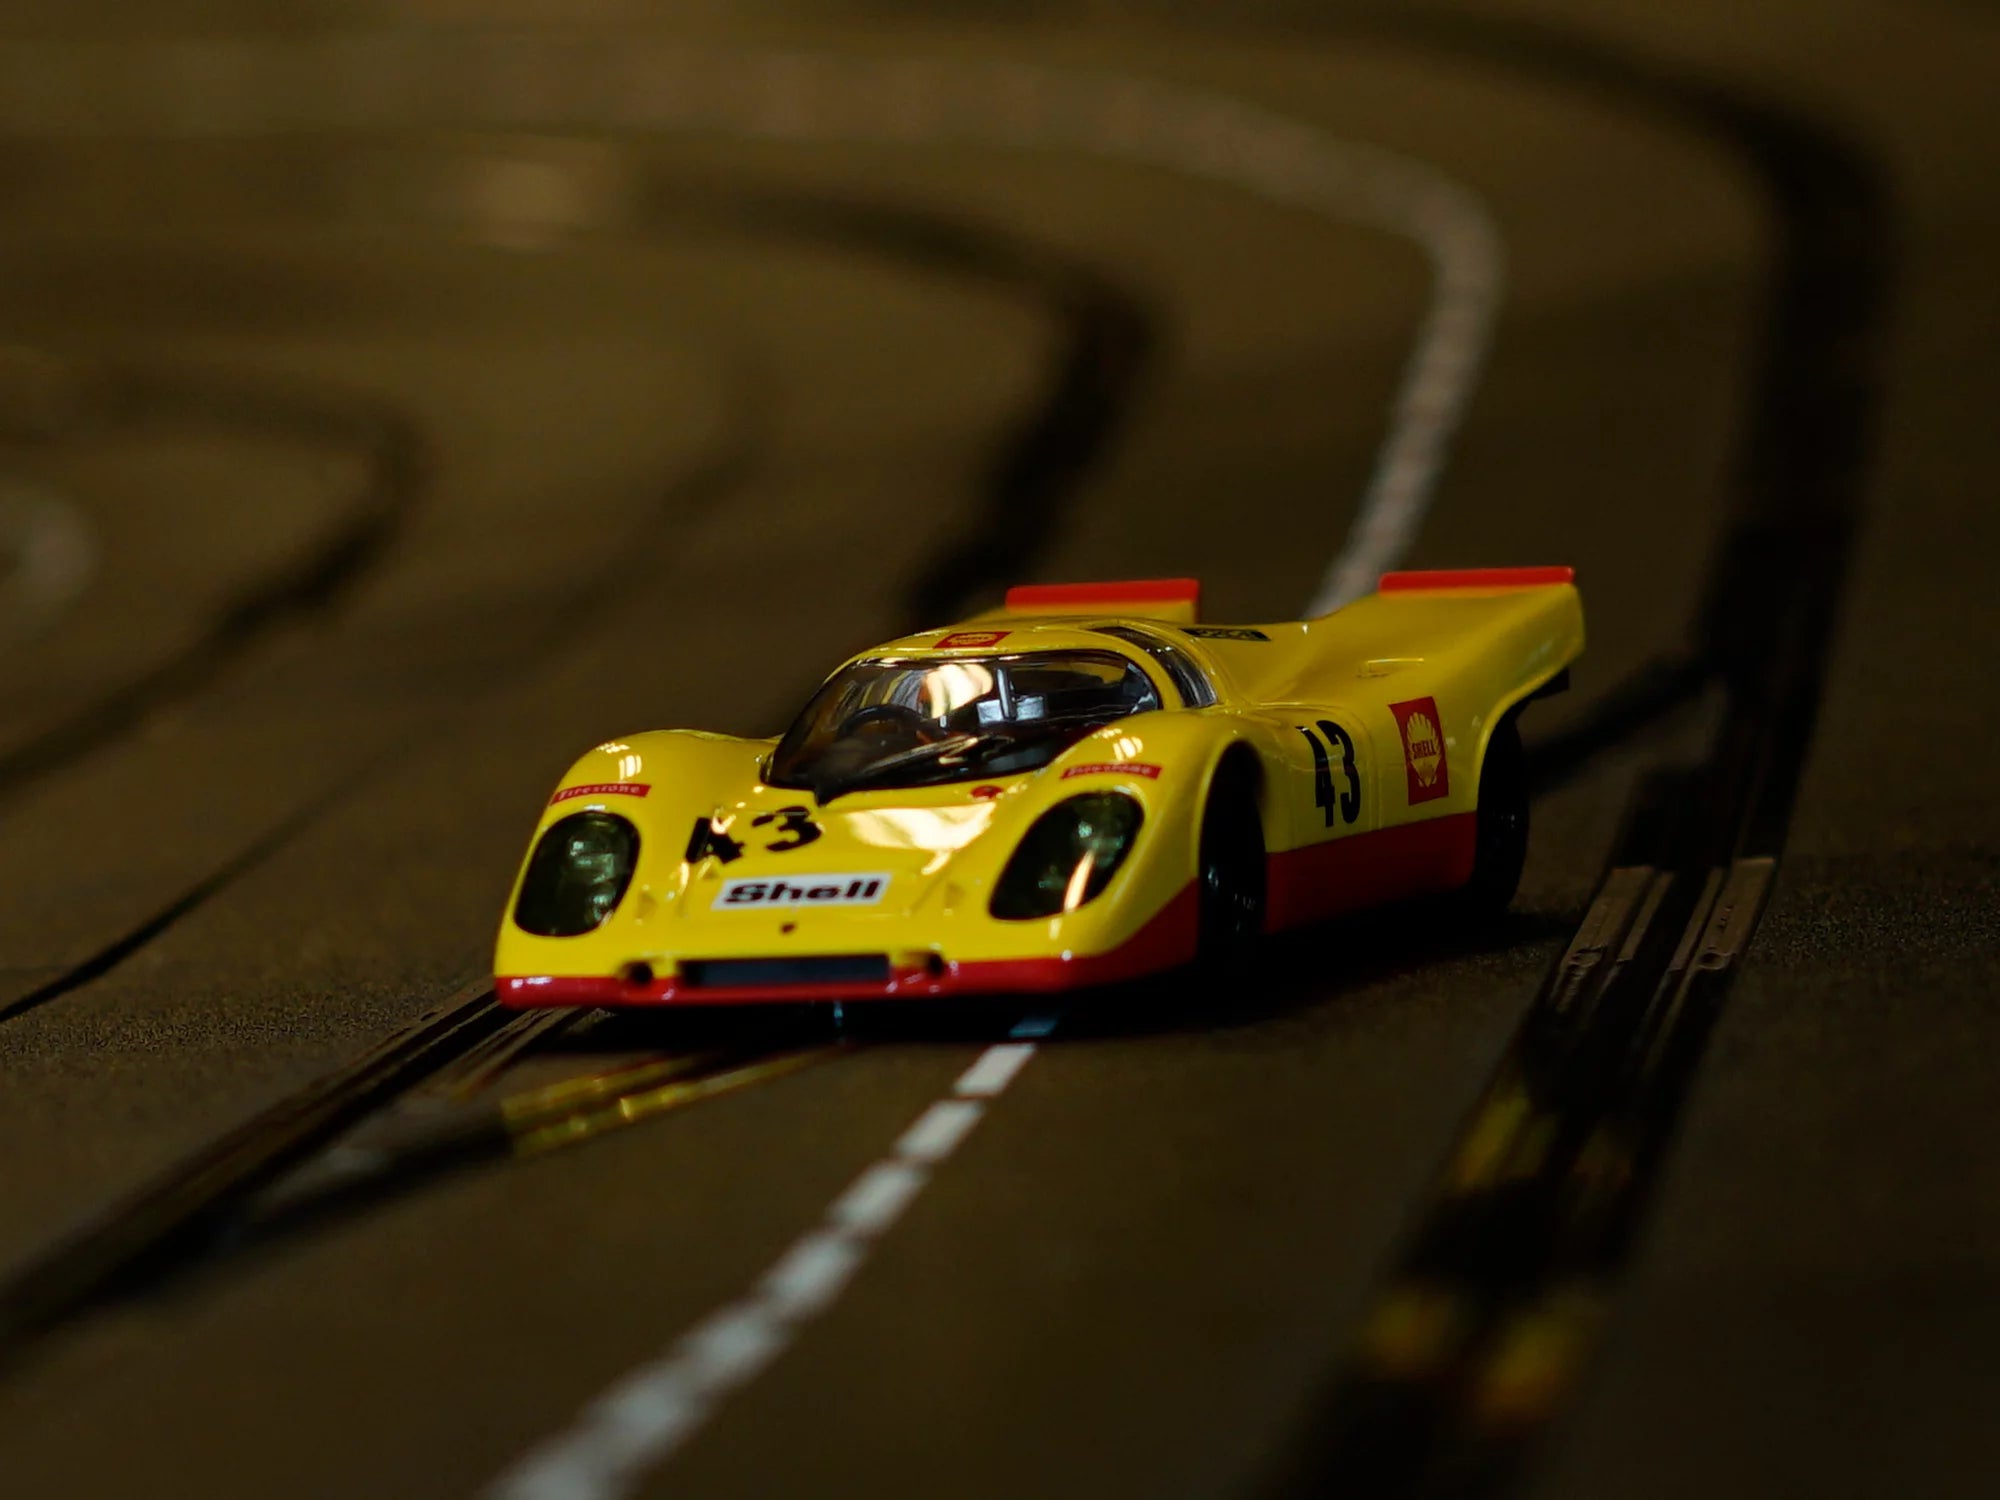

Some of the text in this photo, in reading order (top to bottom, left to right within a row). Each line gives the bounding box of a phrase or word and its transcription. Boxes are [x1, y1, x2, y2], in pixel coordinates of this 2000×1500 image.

[1411, 739, 1437, 759] SHELL
[1295, 719, 1361, 828] 43
[685, 806, 822, 864] 43
[724, 879, 881, 904] Shell
